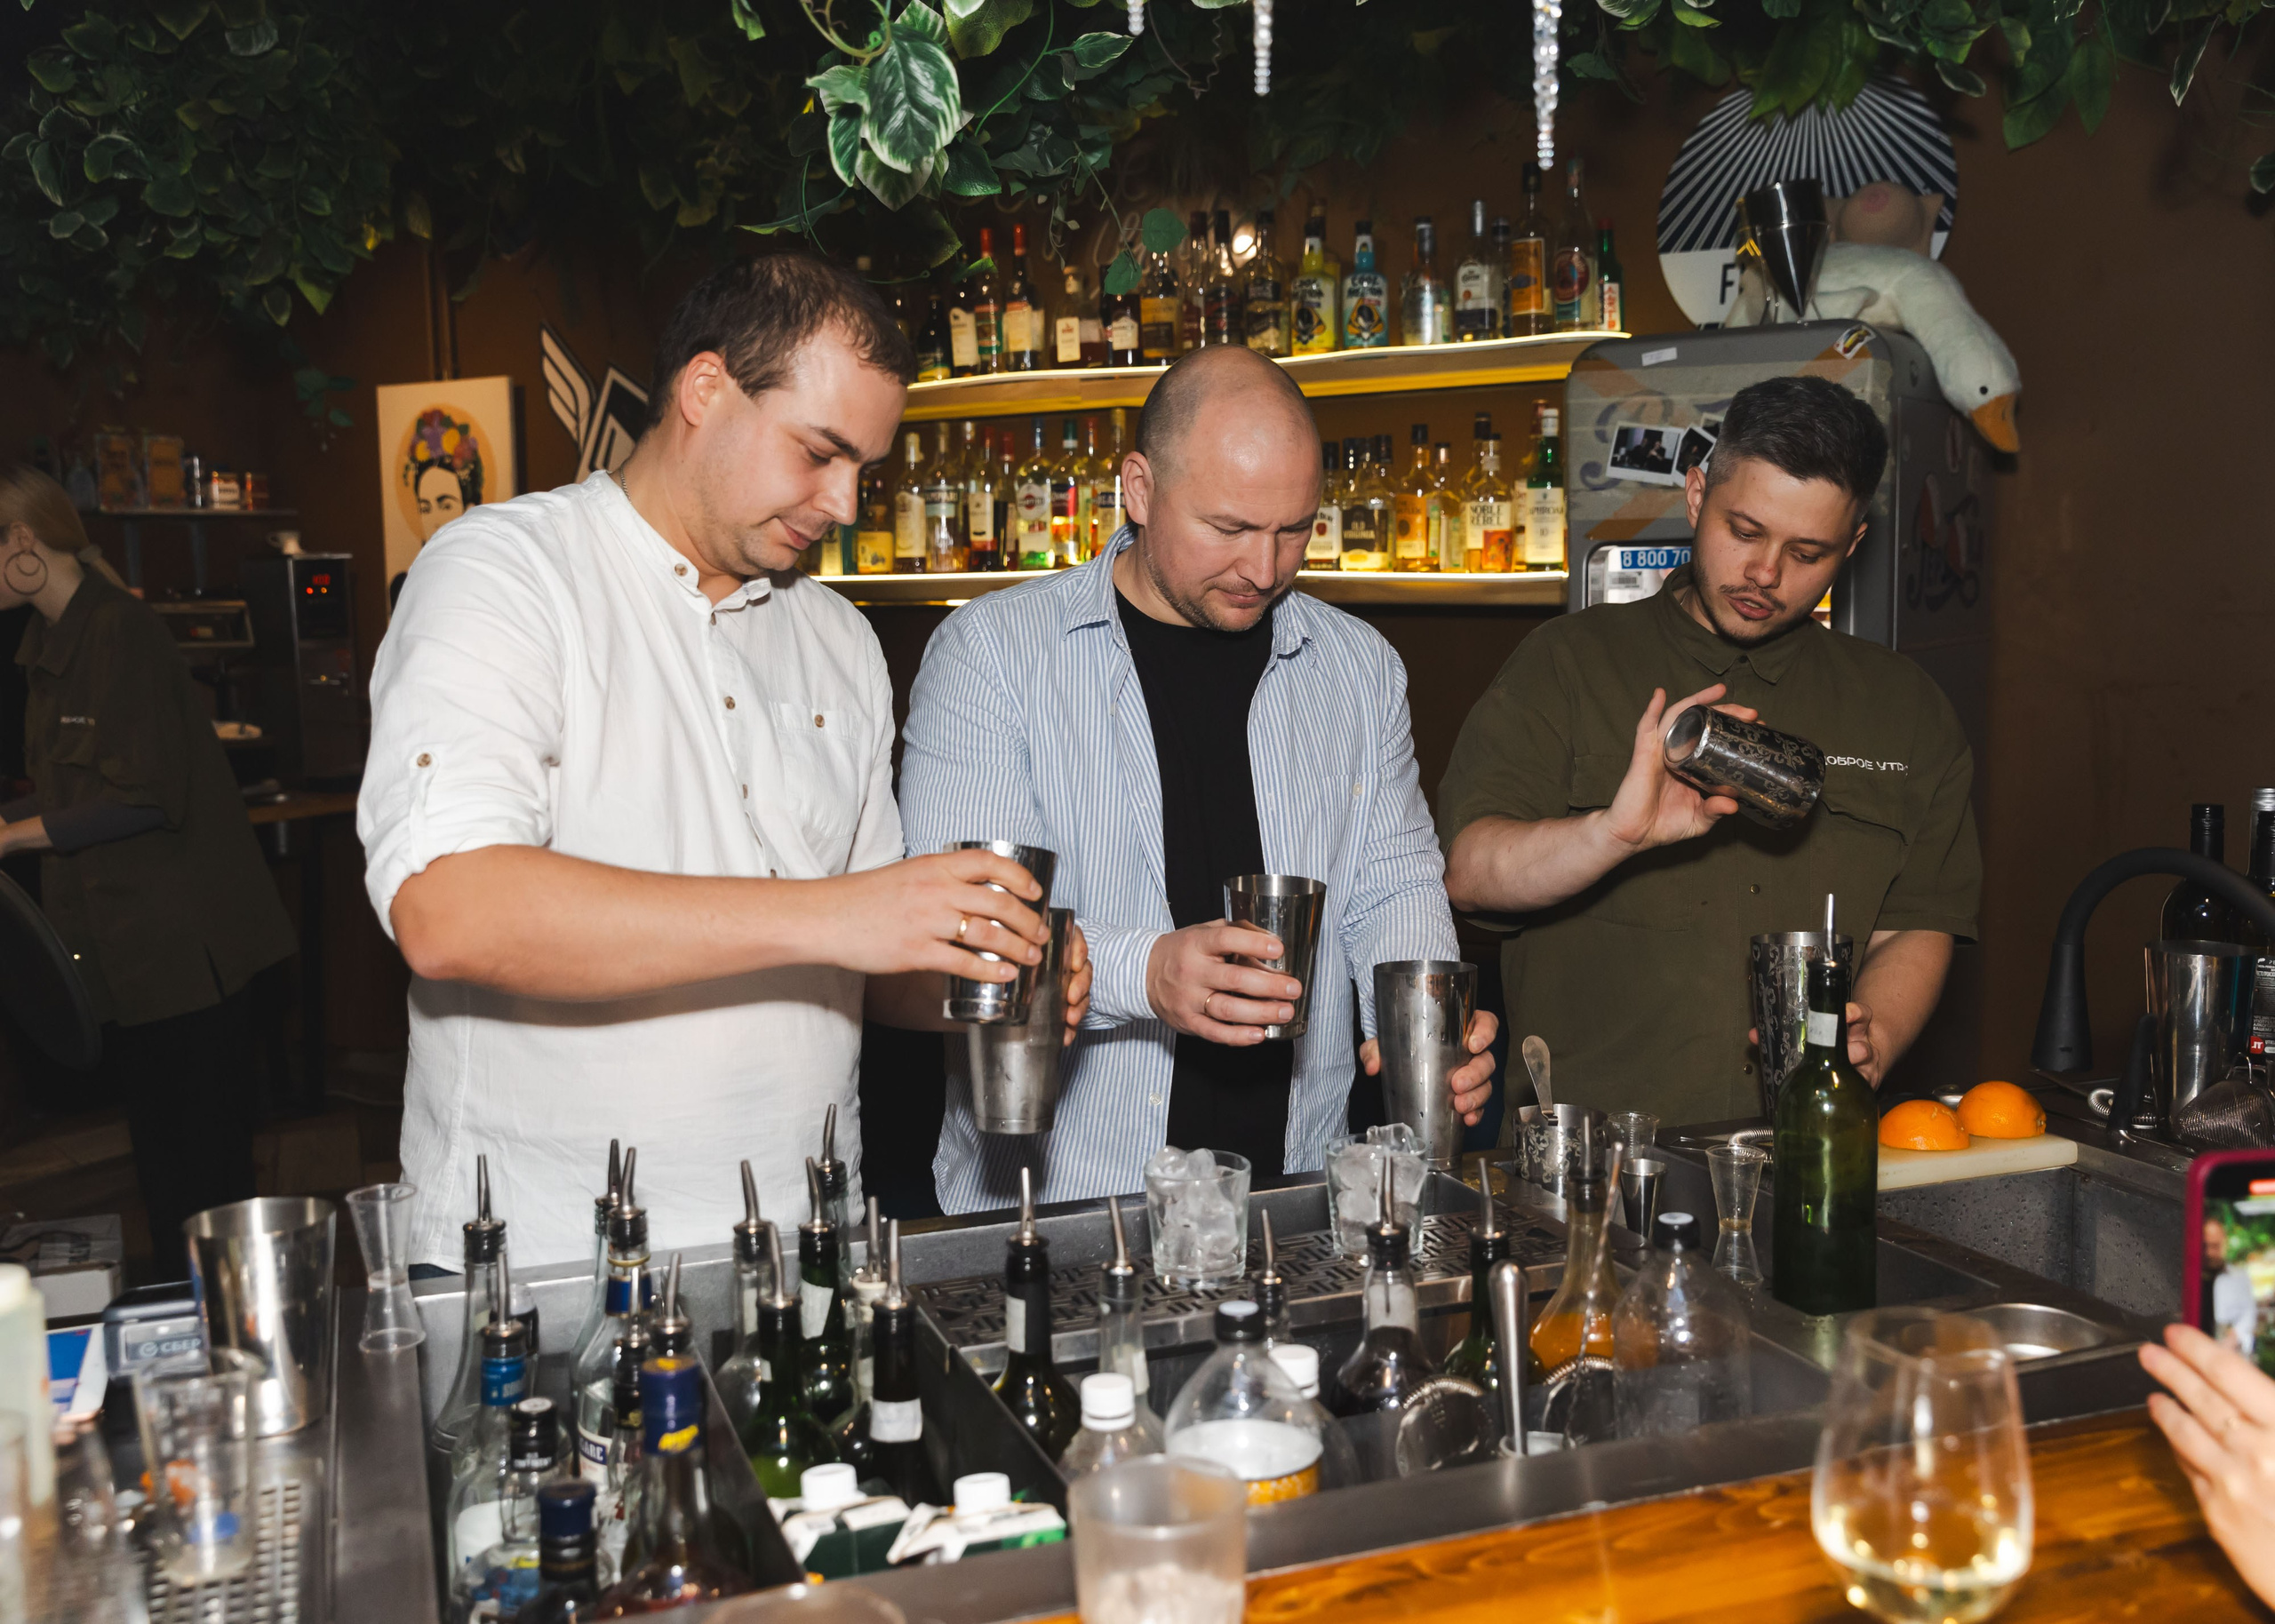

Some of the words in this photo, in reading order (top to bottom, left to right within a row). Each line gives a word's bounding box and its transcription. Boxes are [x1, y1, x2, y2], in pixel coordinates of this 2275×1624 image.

[1623, 552, 1632, 567] 8
[1637, 551, 1667, 567] 800
[1824, 755, 1873, 771] ОБРОЕ
[161, 1338, 202, 1353] СБЕР
